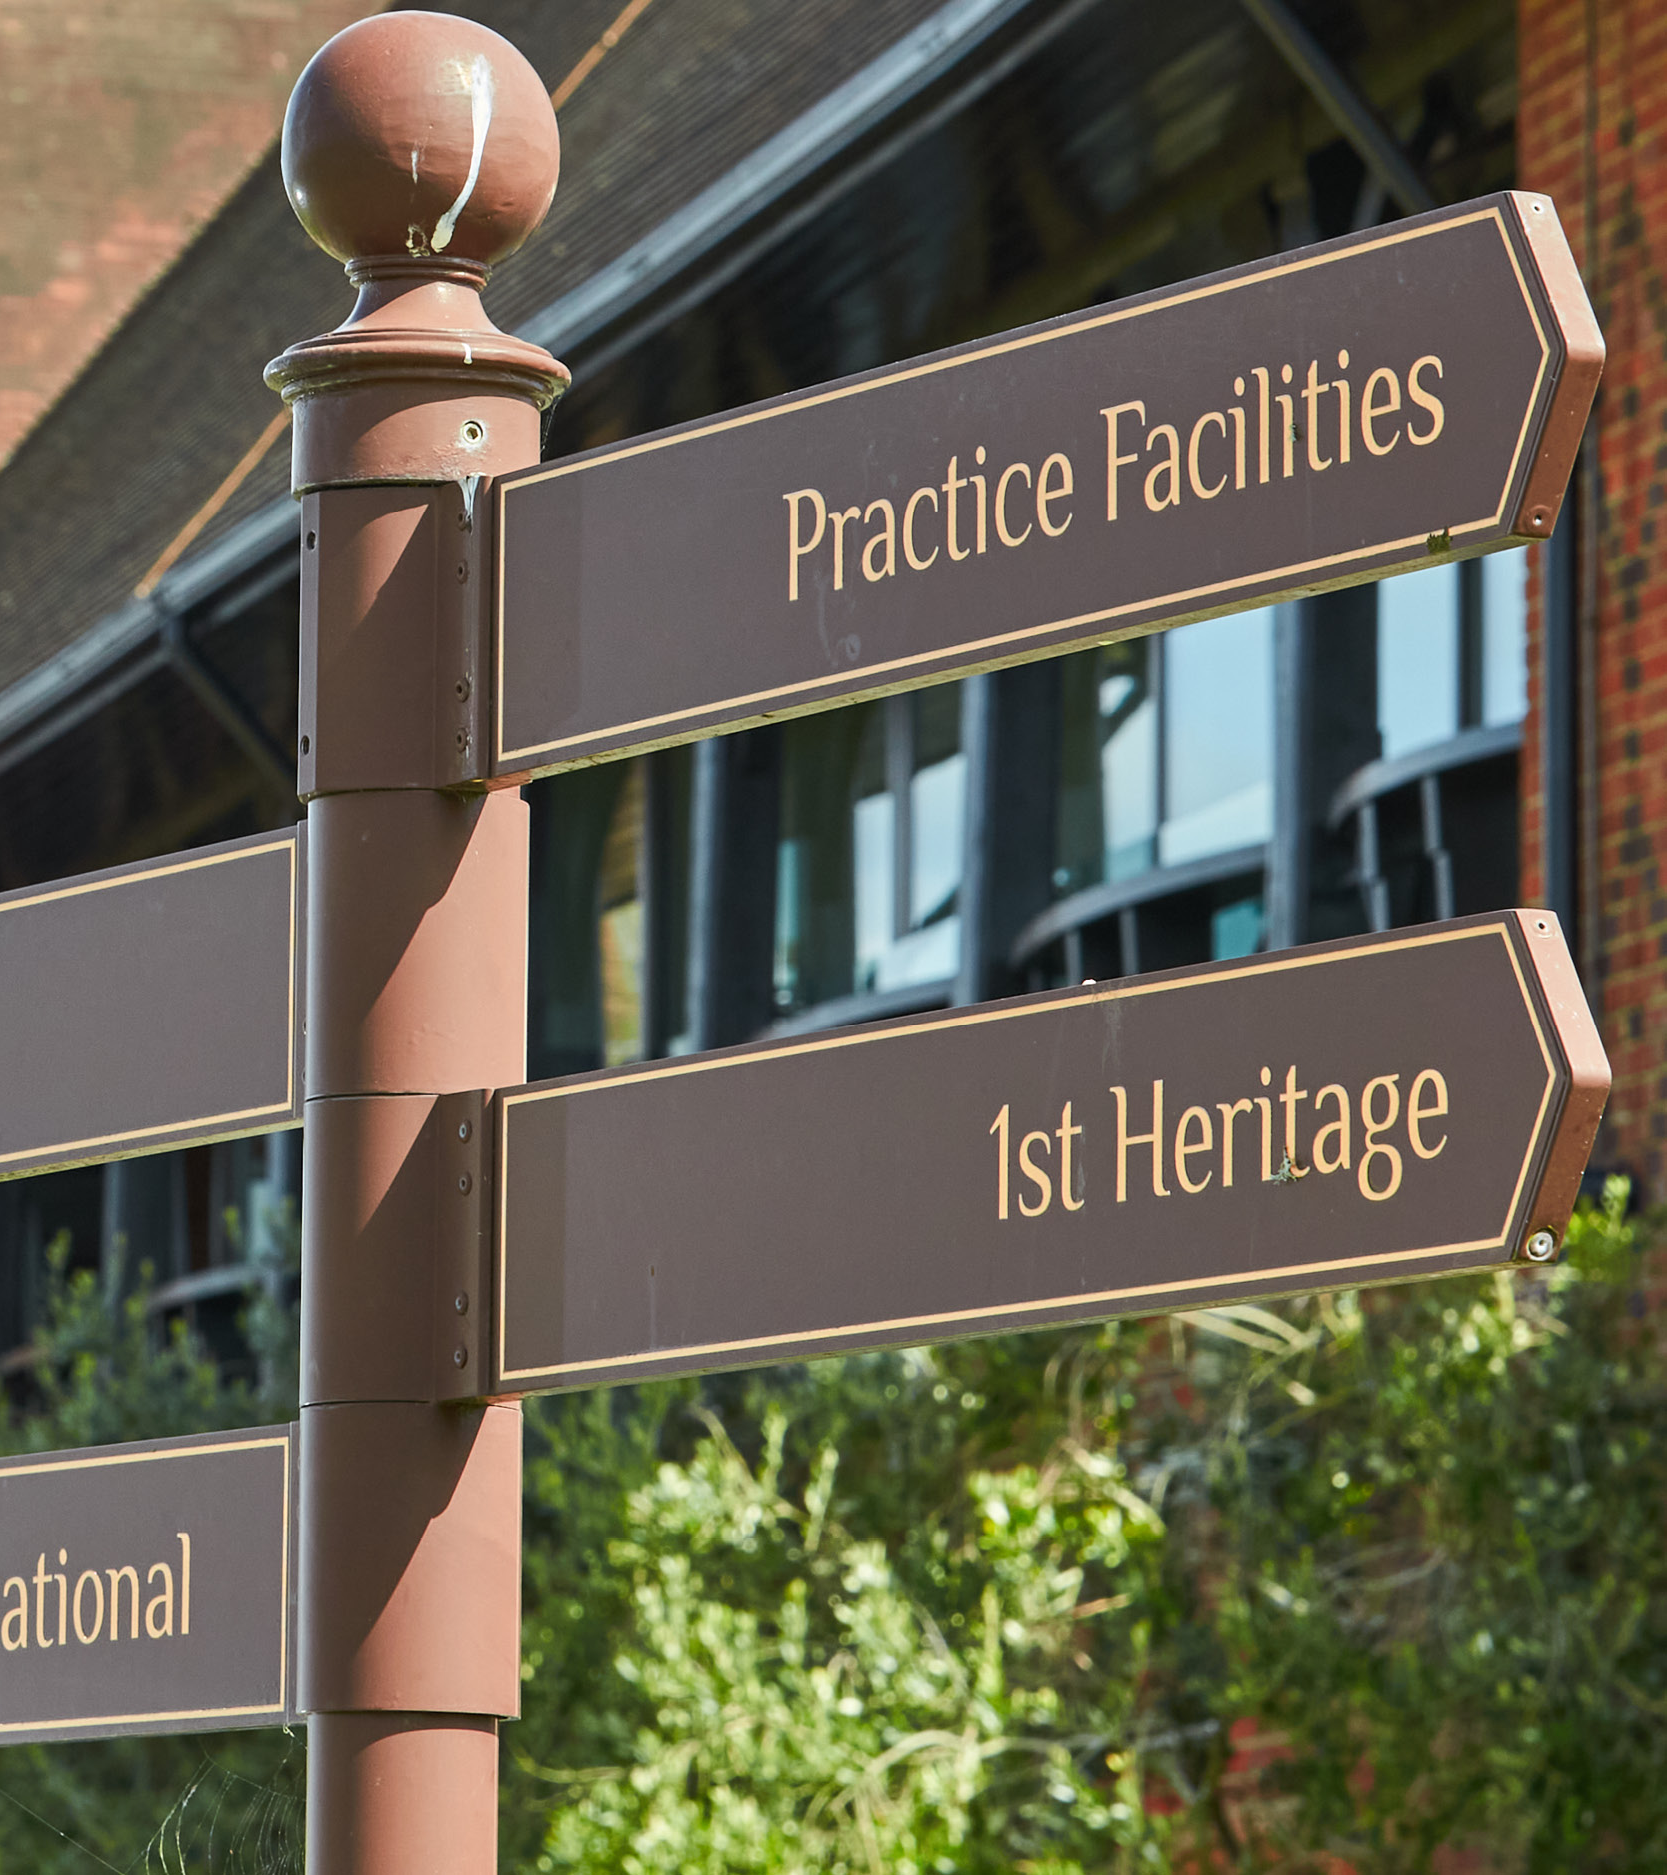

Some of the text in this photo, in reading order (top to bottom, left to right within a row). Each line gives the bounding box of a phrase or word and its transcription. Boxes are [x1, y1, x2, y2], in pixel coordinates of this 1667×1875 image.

[784, 348, 1446, 602] Practice Facilities
[987, 1064, 1450, 1221] 1st Heritage
